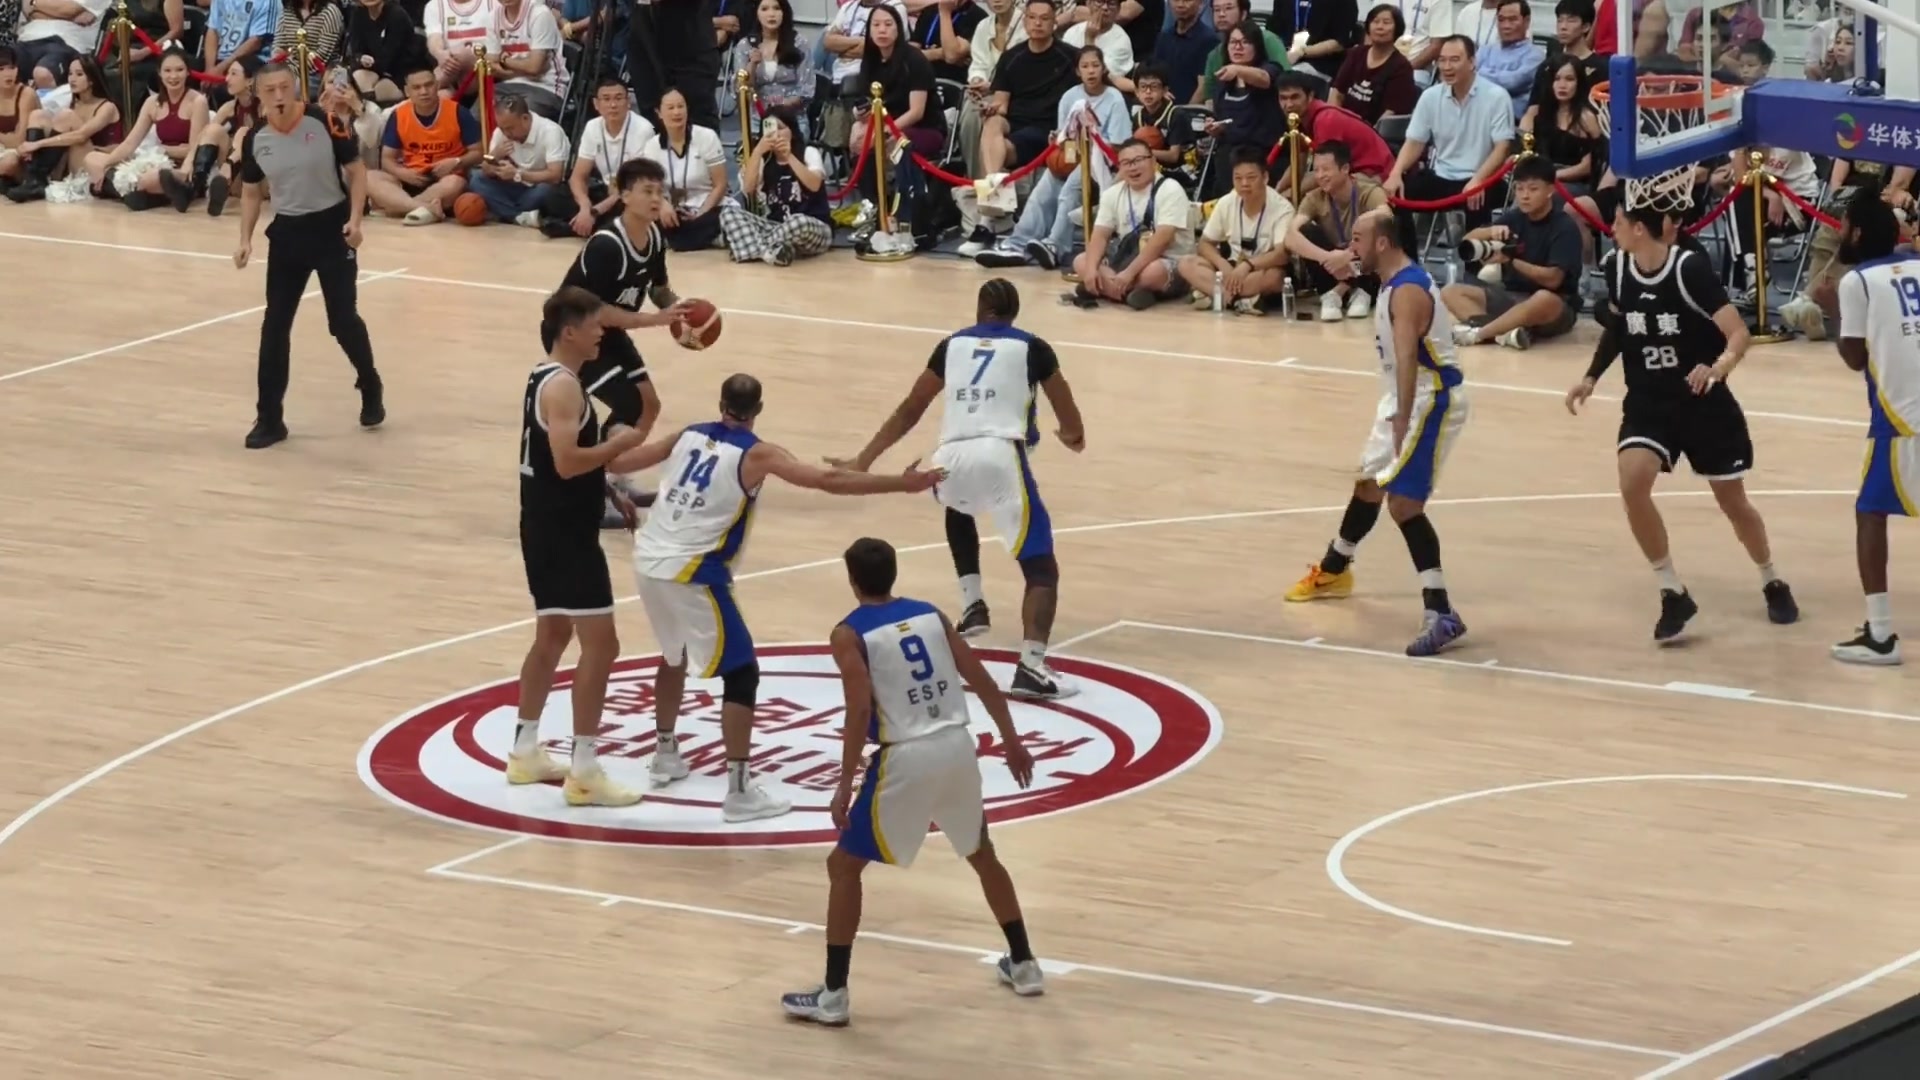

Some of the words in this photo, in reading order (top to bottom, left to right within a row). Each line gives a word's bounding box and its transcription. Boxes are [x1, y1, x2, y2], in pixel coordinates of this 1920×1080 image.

[1890, 276, 1920, 317] 19
[1625, 310, 1681, 336] 廣東
[969, 348, 996, 386] 7
[1641, 345, 1679, 369] 28
[956, 387, 996, 402] ESP
[678, 448, 719, 493] 14
[665, 487, 706, 509] ESP
[899, 634, 934, 682] 9
[907, 680, 948, 705] ESP
